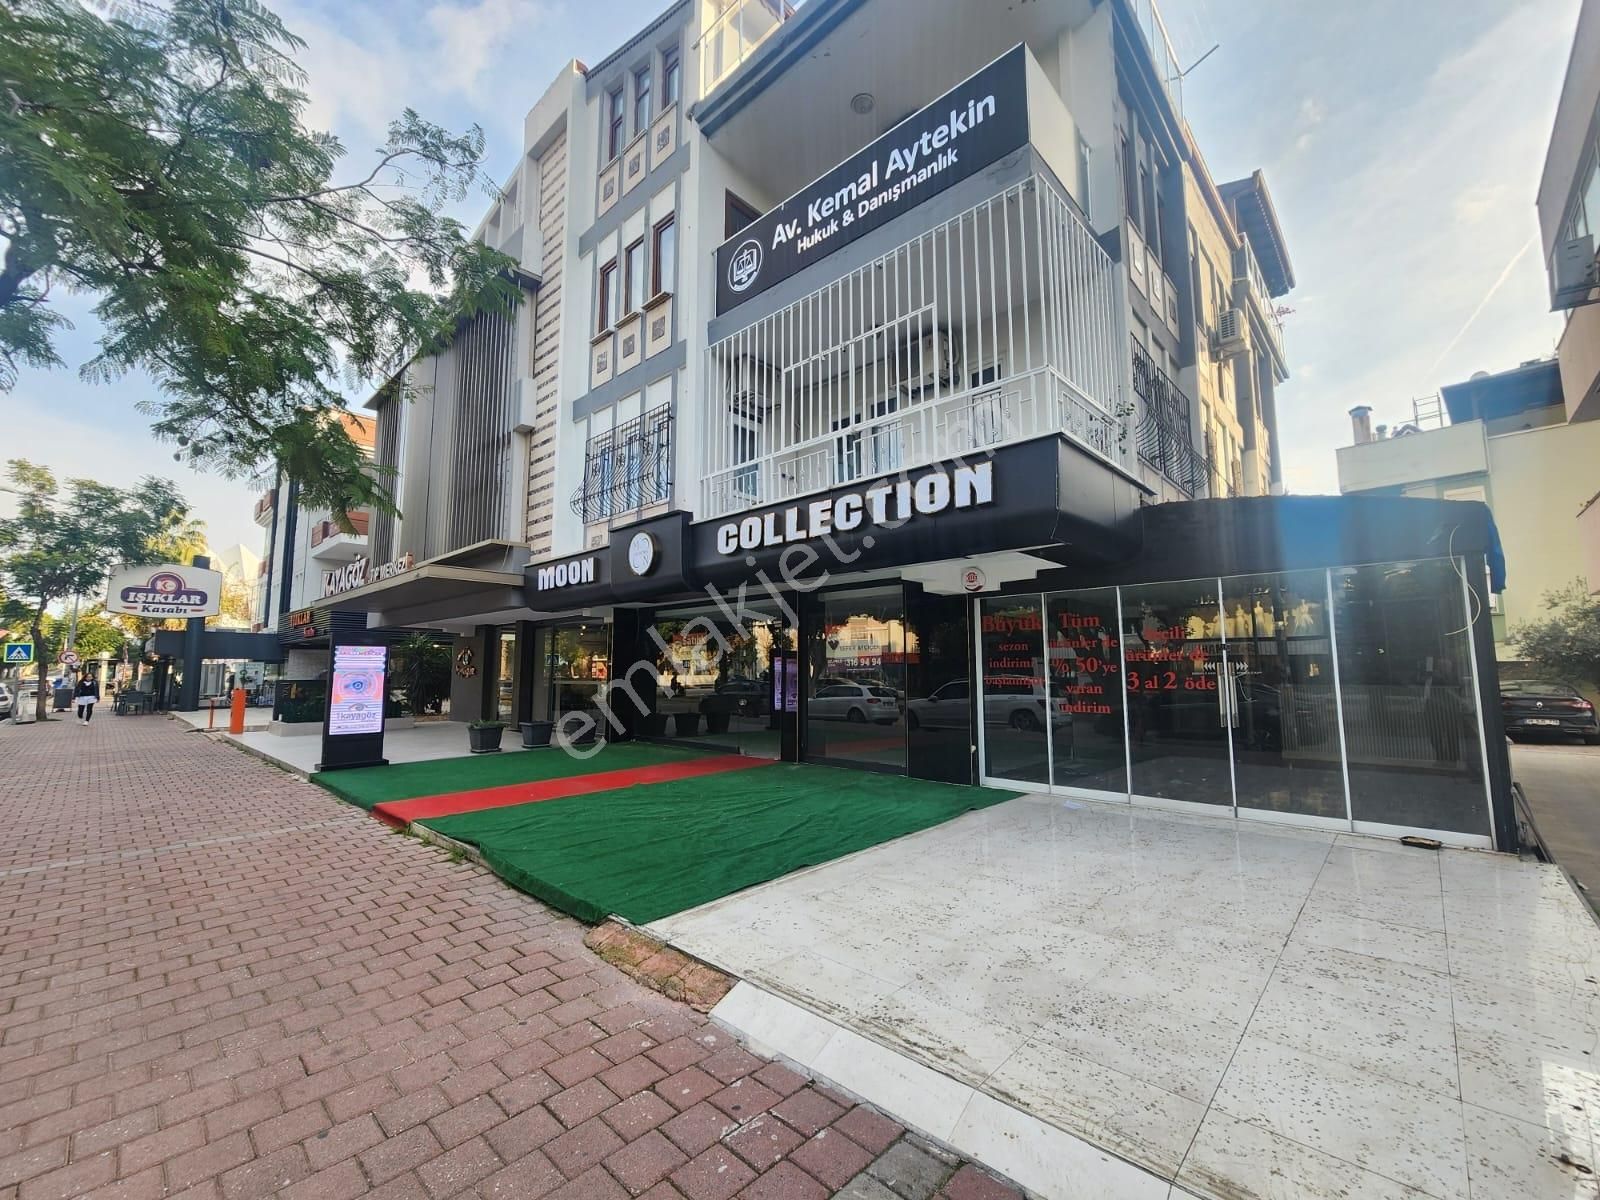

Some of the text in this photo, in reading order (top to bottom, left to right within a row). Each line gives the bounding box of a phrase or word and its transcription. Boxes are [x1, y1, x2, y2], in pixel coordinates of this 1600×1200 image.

[771, 95, 996, 250] Av. Kemal Aytekin
[797, 147, 959, 254] Hukuk & Danışmanlık
[537, 556, 595, 591] MOON
[716, 460, 993, 556] COLLECTION
[322, 553, 369, 598] KAYAGÖZ
[127, 591, 201, 604] IŞIKLAR
[141, 604, 188, 614] Kasabı
[982, 612, 1042, 636] Büyük
[1058, 612, 1100, 628] Tüm
[998, 641, 1029, 652] sezon
[1065, 685, 1104, 694] varan
[1127, 671, 1217, 690] 3 al 2 öde
